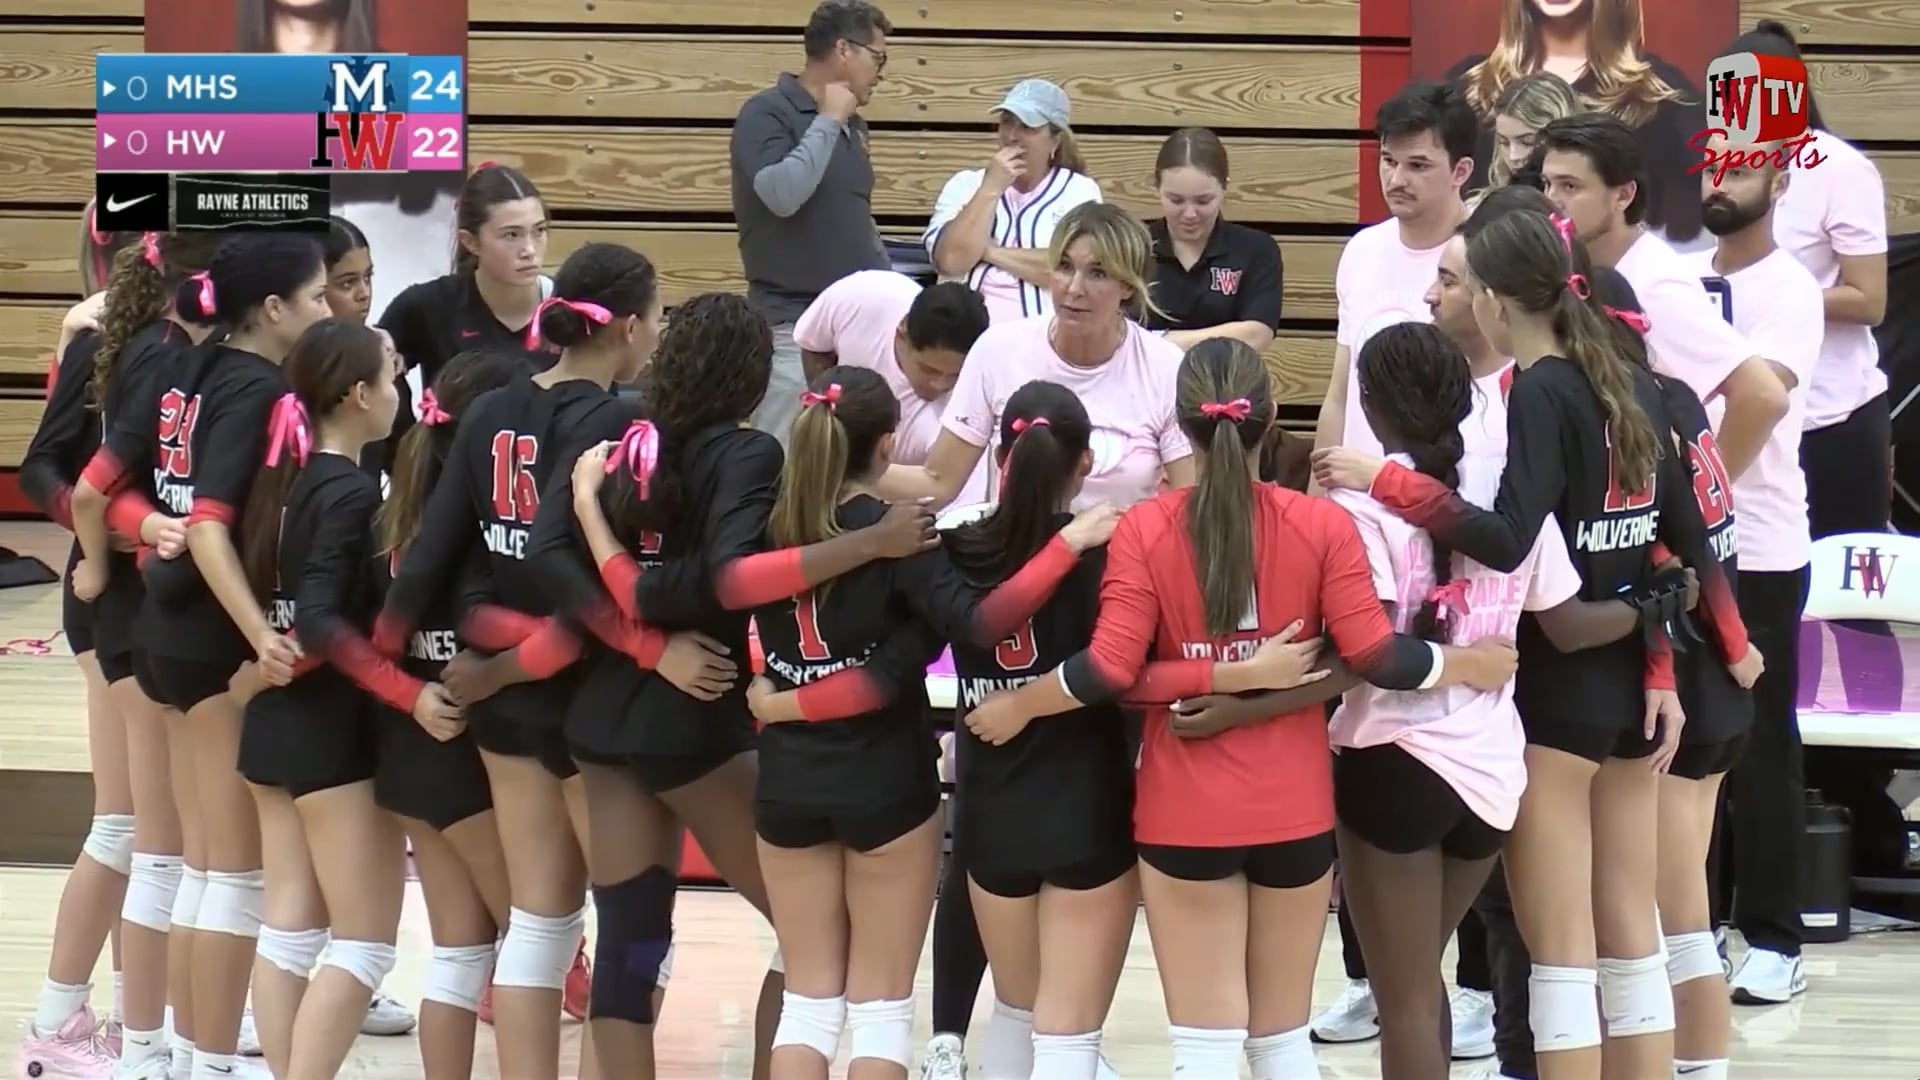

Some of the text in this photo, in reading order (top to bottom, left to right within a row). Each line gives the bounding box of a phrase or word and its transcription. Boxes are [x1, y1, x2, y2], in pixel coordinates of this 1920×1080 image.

[1210, 266, 1243, 295] HW
[491, 429, 540, 525] 16
[1839, 545, 1900, 600] HW
